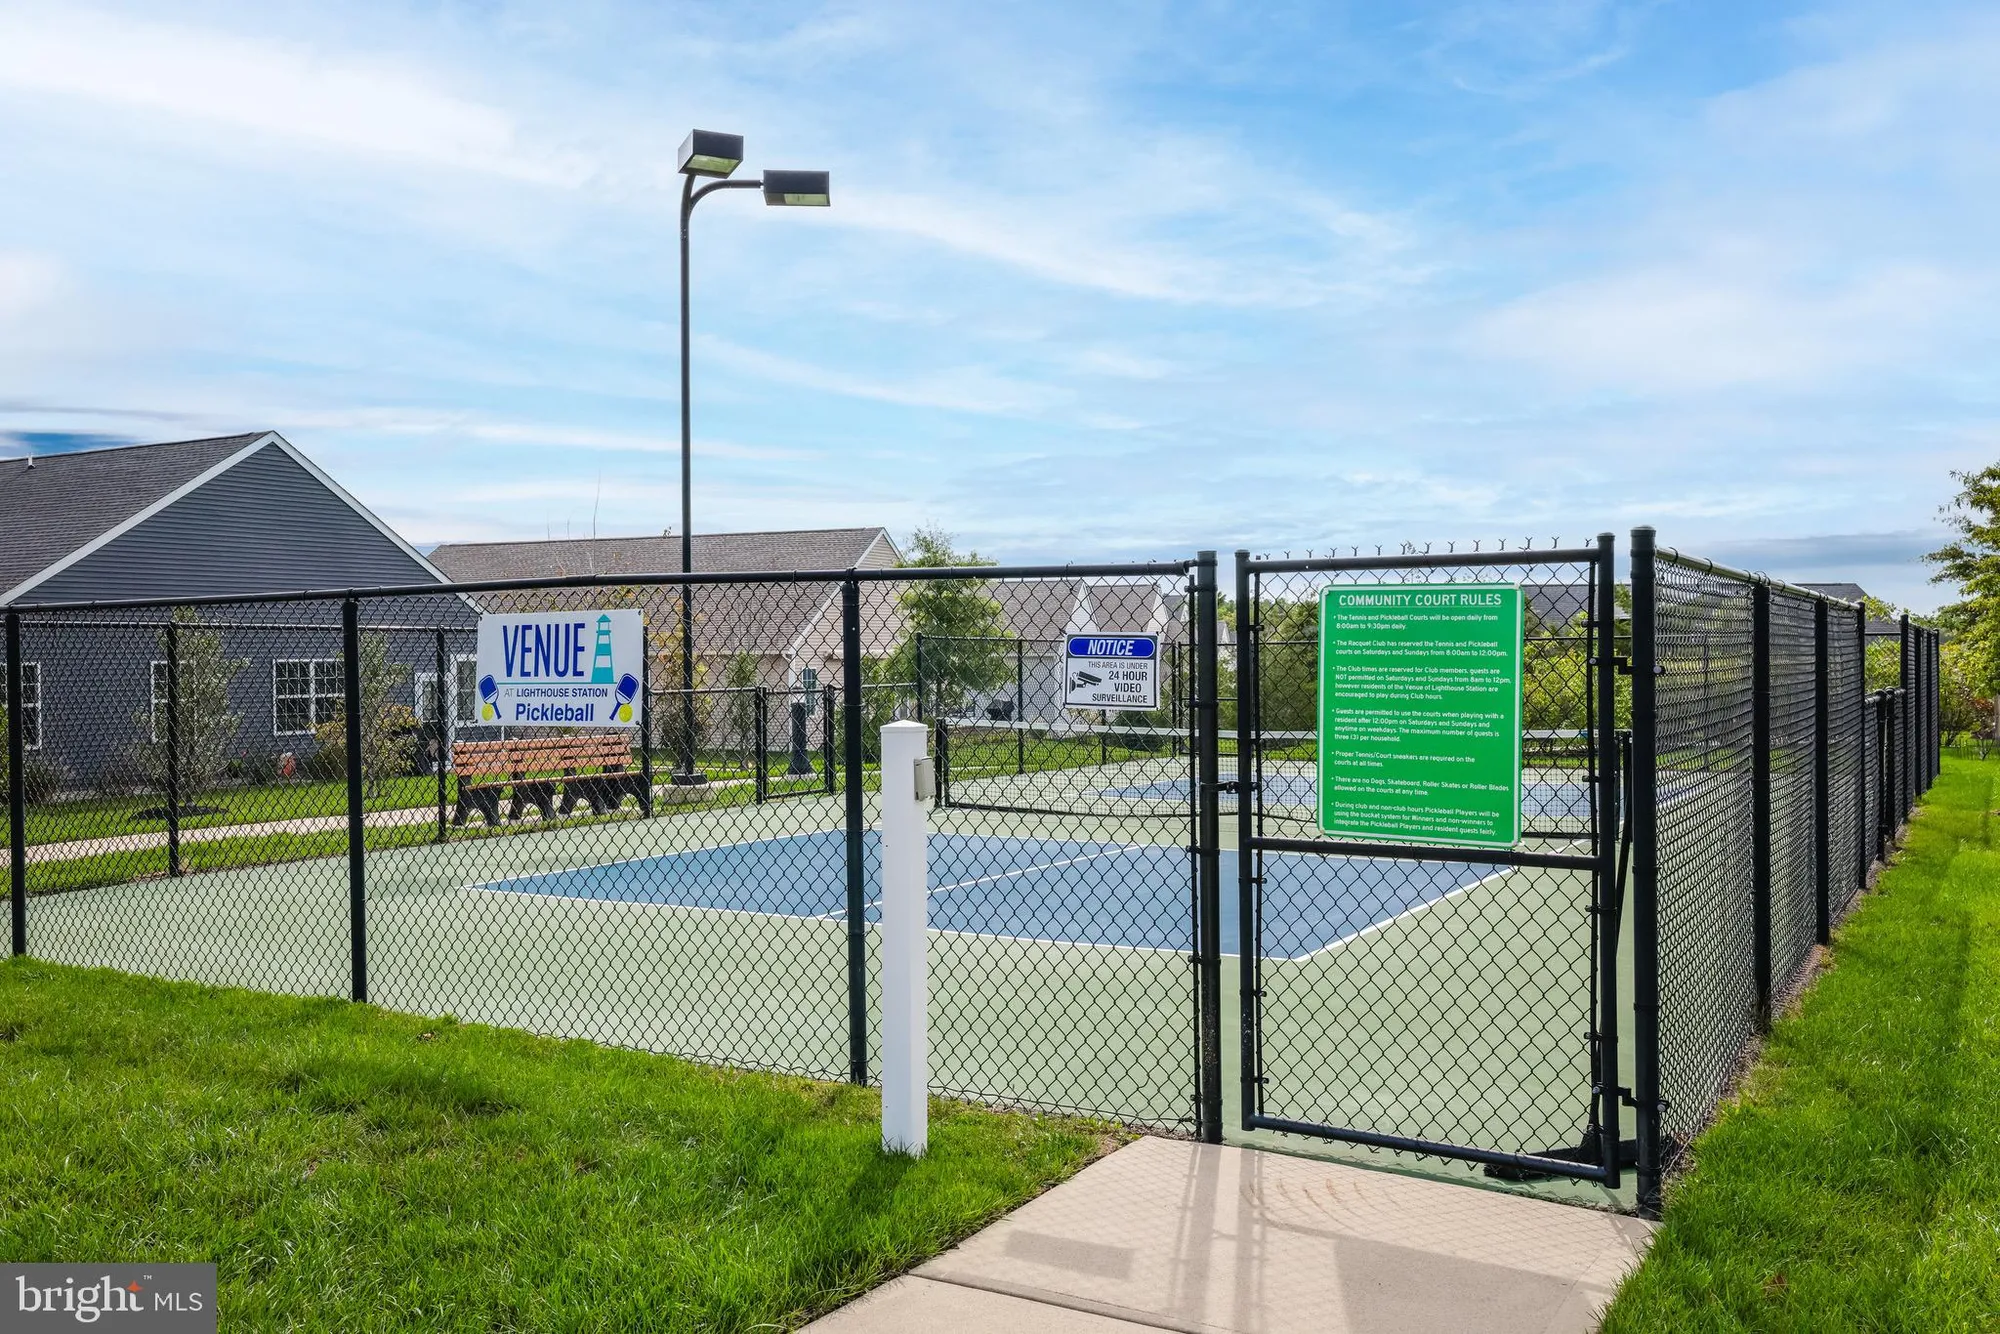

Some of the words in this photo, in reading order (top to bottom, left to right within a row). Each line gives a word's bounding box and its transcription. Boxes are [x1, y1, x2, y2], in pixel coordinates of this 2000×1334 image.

[1339, 595, 1411, 606] COMMUNITY
[1415, 594, 1457, 605] COURT
[1460, 594, 1502, 605] RULES
[1466, 614, 1482, 622] daily
[1088, 640, 1135, 655] NOTICE
[1348, 640, 1371, 648] Racquet
[503, 623, 585, 677] VENUE
[1362, 649, 1391, 657] Saturdays
[1404, 649, 1429, 657] Sundays
[1102, 661, 1117, 669] AREA
[1109, 671, 1119, 680] 24
[1123, 671, 1147, 681] HOUR
[1348, 674, 1376, 682] permitted
[1385, 675, 1414, 683] Saturdays
[1428, 676, 1453, 684] Sundays
[504, 688, 514, 698] AT
[517, 688, 569, 698] LIGHTHOUSE
[572, 688, 607, 698] STATION
[1114, 683, 1141, 693] VIDEO
[1431, 684, 1465, 693] Lighthouse
[1092, 693, 1147, 703] SURVEILLANCE
[1335, 691, 1368, 700] encouraged
[1376, 692, 1389, 700] play
[516, 703, 594, 721] Pickleball
[1365, 709, 1393, 717] permitted
[1460, 711, 1484, 720] playing
[1408, 719, 1437, 727] Saturdays
[1451, 720, 1477, 729] Sundays
[1335, 725, 1358, 734] anytime
[1474, 730, 1494, 738] guests
[1335, 751, 1354, 759] Proper
[1429, 755, 1455, 763] required
[1335, 802, 1354, 810] During
[1380, 804, 1406, 812] non-club
[1455, 808, 1477, 817] Players
[1381, 813, 1401, 822] system
[1448, 817, 1486, 825] non-winners
[1399, 823, 1421, 831] Players
[1459, 826, 1478, 835] guests
